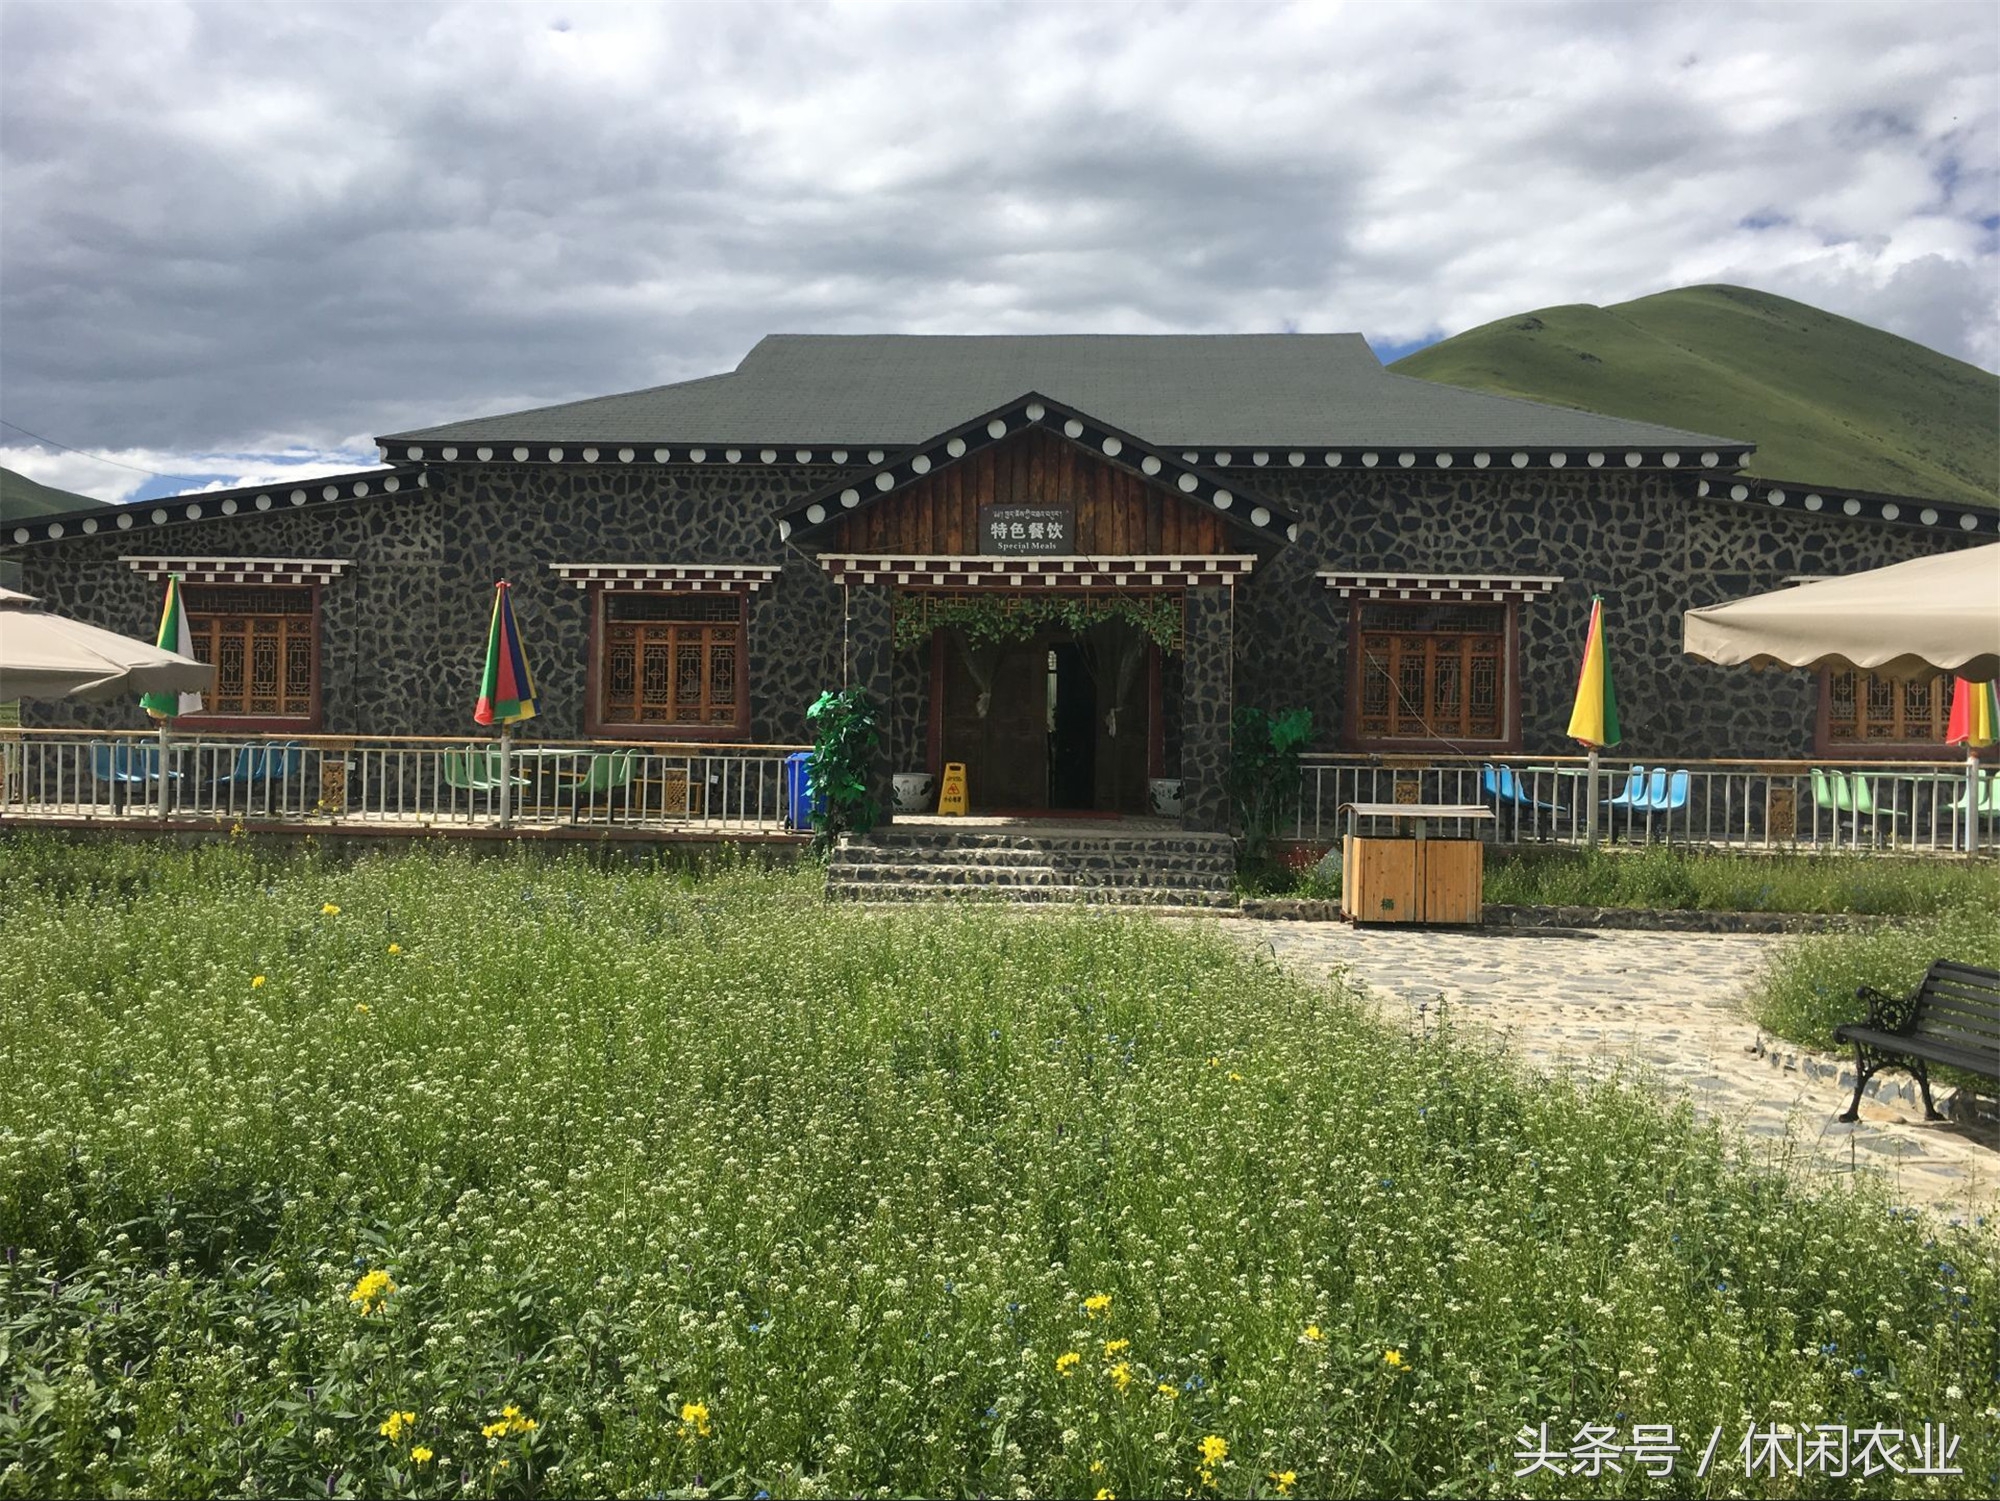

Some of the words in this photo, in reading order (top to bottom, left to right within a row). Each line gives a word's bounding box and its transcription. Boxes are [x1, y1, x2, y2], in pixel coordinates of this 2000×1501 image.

[990, 522, 1063, 539] 特色餐饮
[998, 542, 1029, 551] Special
[1031, 542, 1057, 550] Meals
